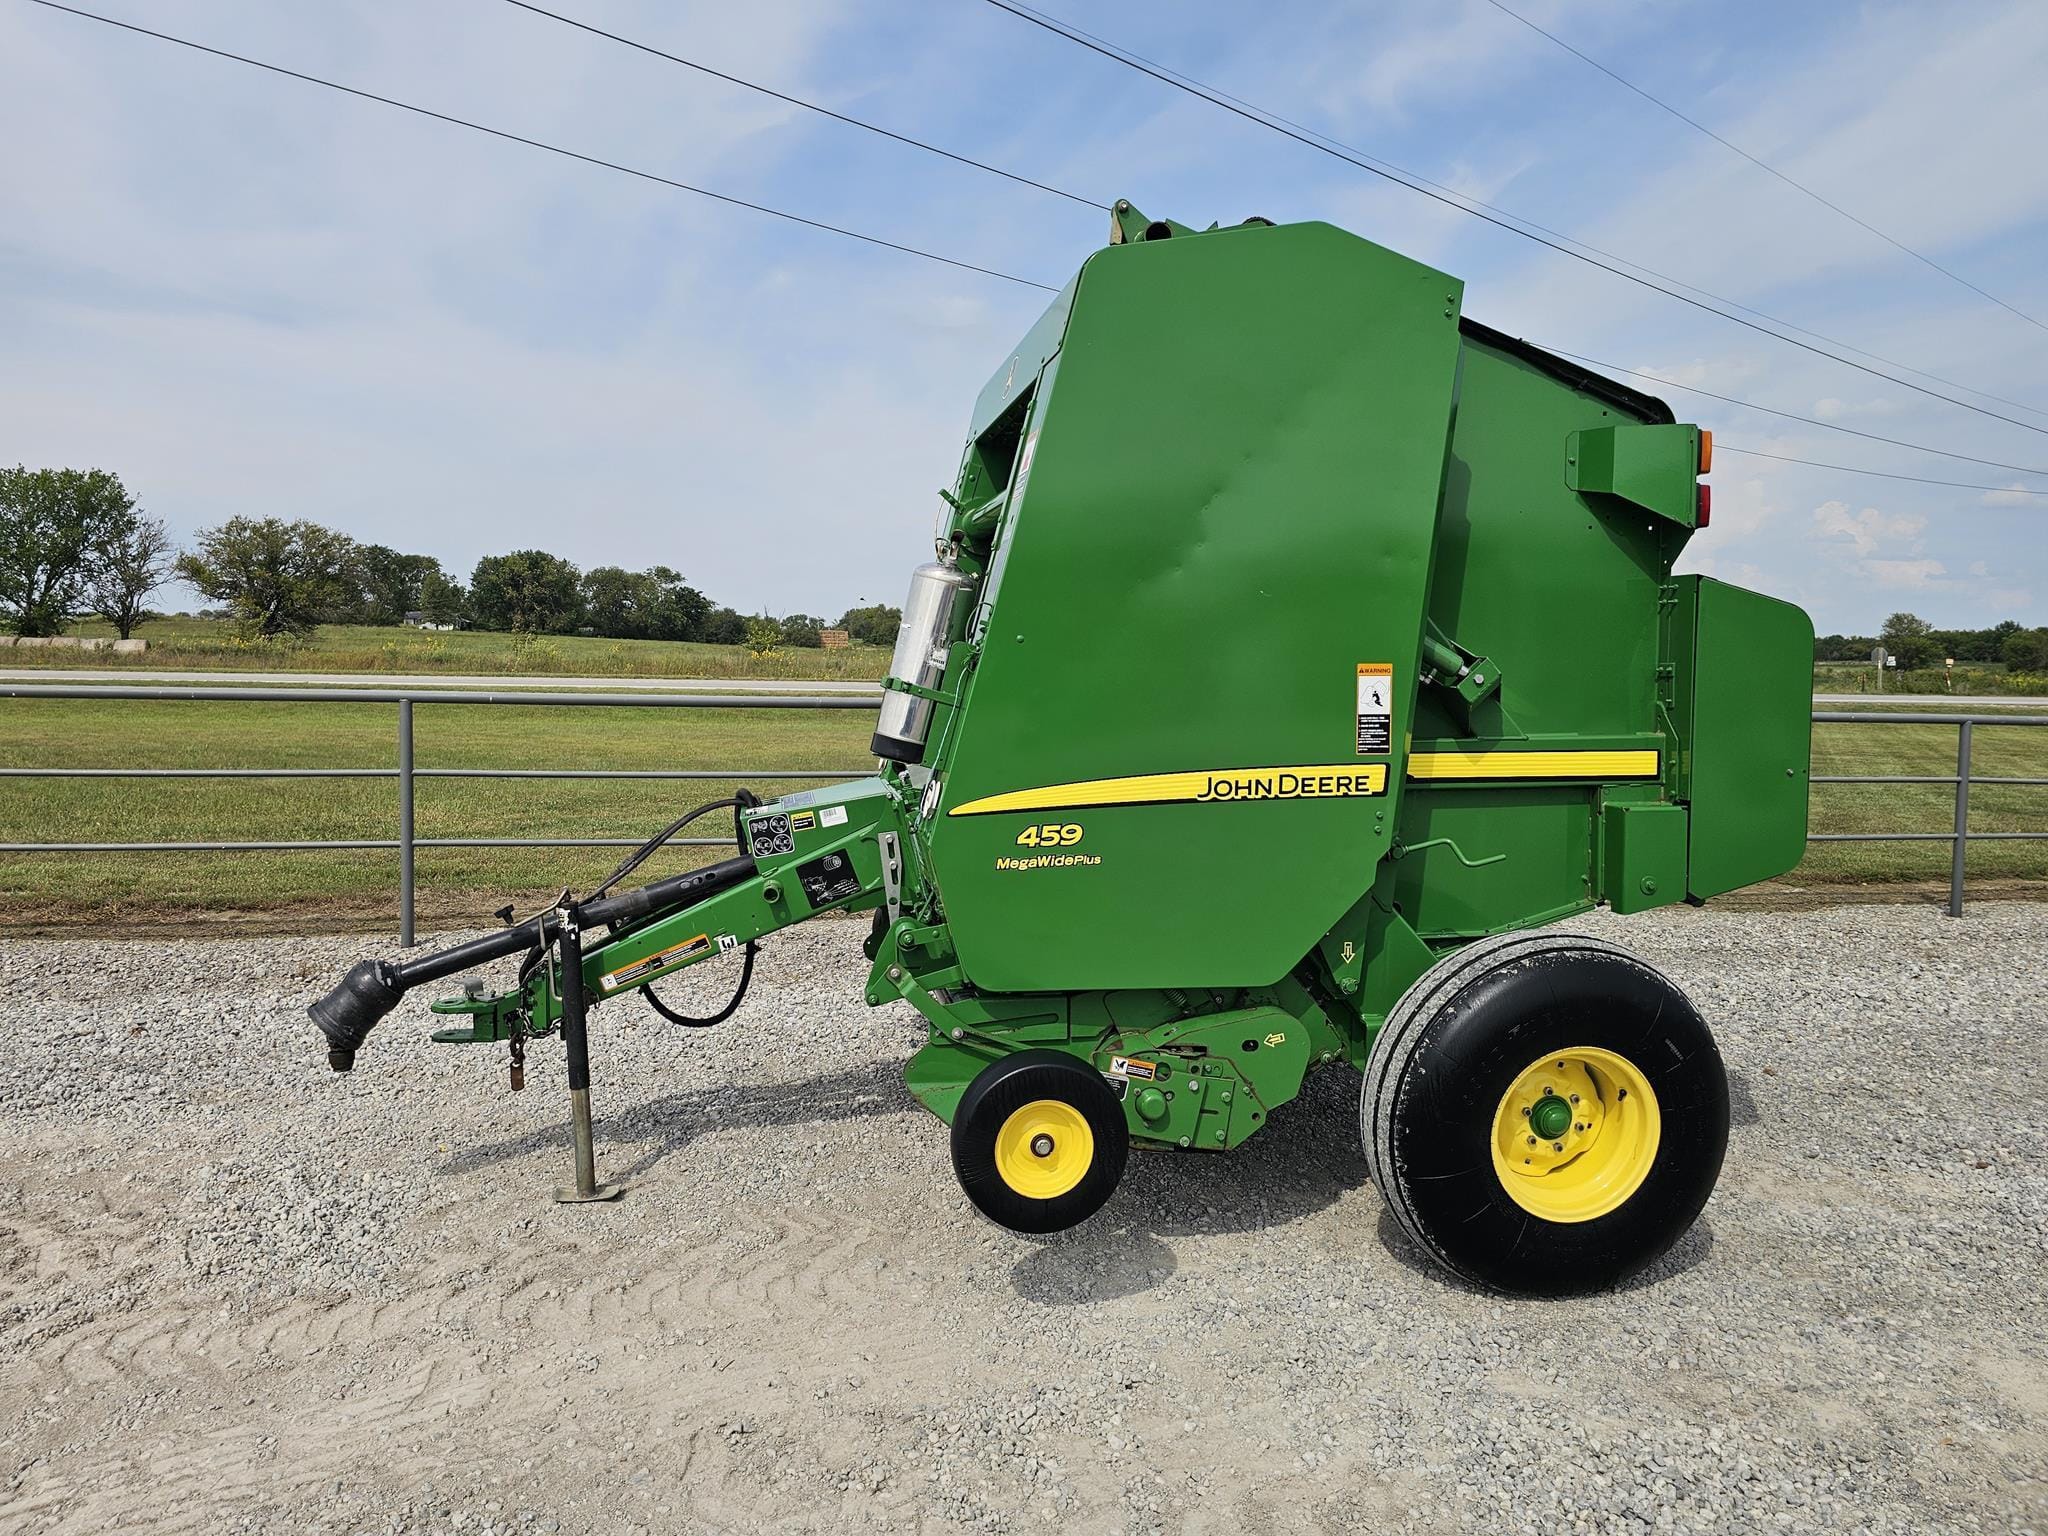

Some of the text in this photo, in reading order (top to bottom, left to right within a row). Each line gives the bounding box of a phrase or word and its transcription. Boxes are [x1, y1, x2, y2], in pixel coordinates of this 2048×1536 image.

[1197, 774, 1370, 798] JOHN DEERE
[1016, 823, 1084, 848] 459
[995, 855, 1102, 870] MegaWidePlus
